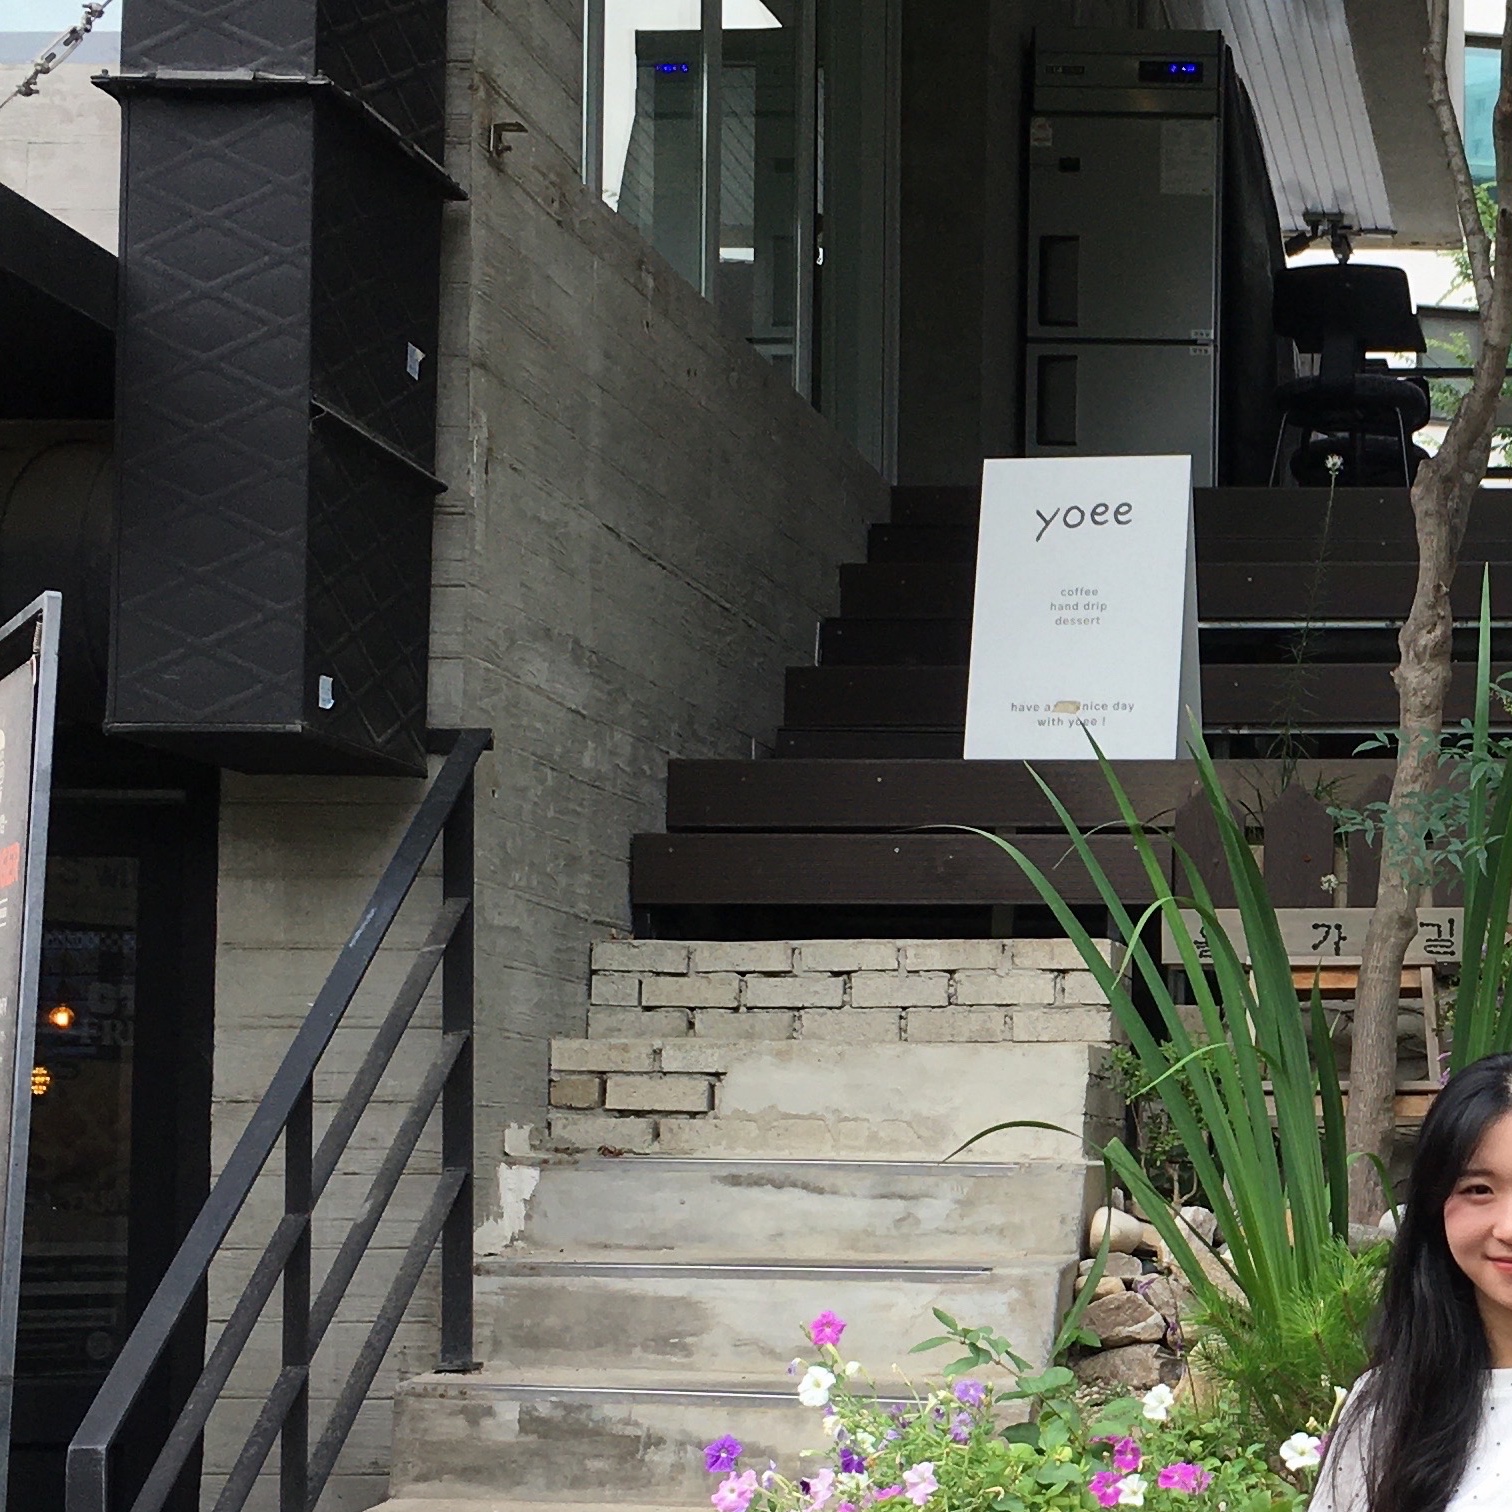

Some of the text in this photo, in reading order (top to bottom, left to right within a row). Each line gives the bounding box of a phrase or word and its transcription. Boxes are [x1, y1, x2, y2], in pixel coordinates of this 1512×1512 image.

[1034, 501, 1133, 542] yoee
[1060, 586, 1099, 597] coffee
[1049, 601, 1108, 613] hand drip
[1054, 616, 1101, 626] dessert
[1010, 702, 1040, 712] have
[1081, 701, 1109, 711] nice
[1112, 701, 1135, 712] day
[1037, 716, 1064, 727] with
